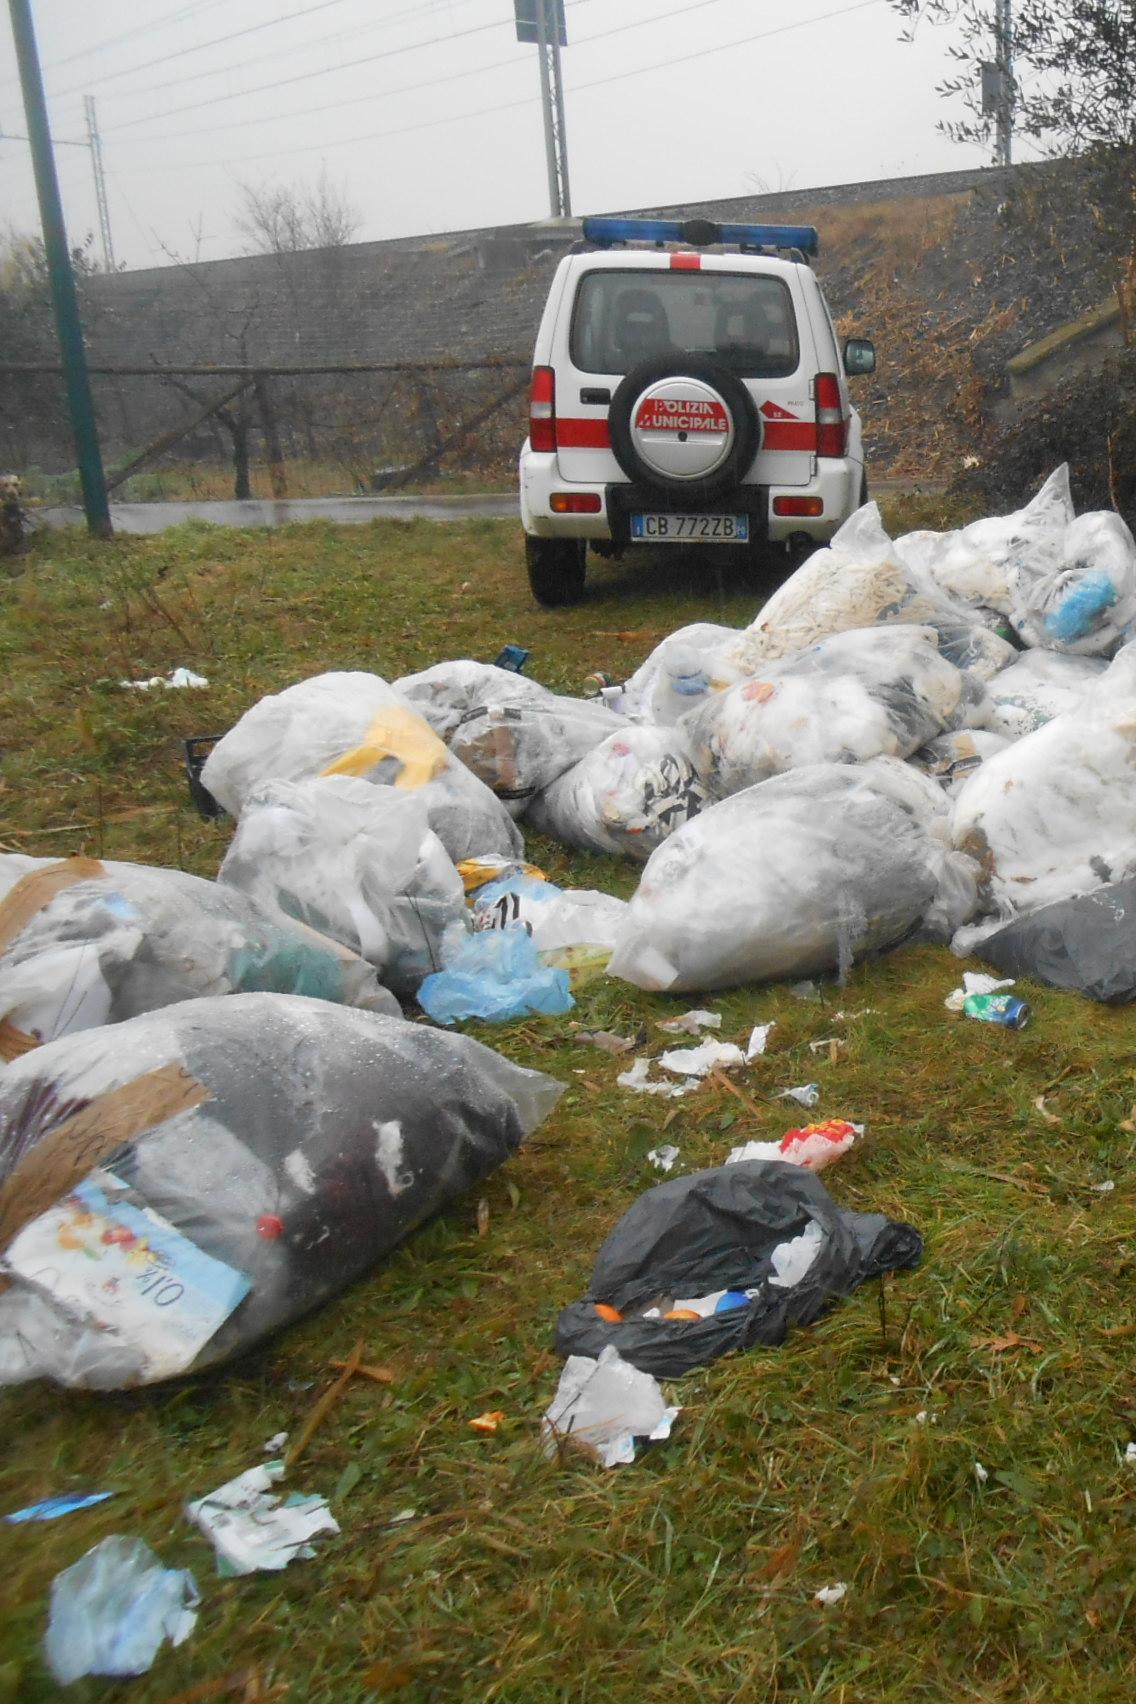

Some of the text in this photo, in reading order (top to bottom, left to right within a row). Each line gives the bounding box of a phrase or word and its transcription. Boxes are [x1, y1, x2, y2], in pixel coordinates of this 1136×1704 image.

[654, 400, 714, 414] POLIZIA
[646, 516, 668, 535] CB
[676, 517, 734, 536] 772ZB
